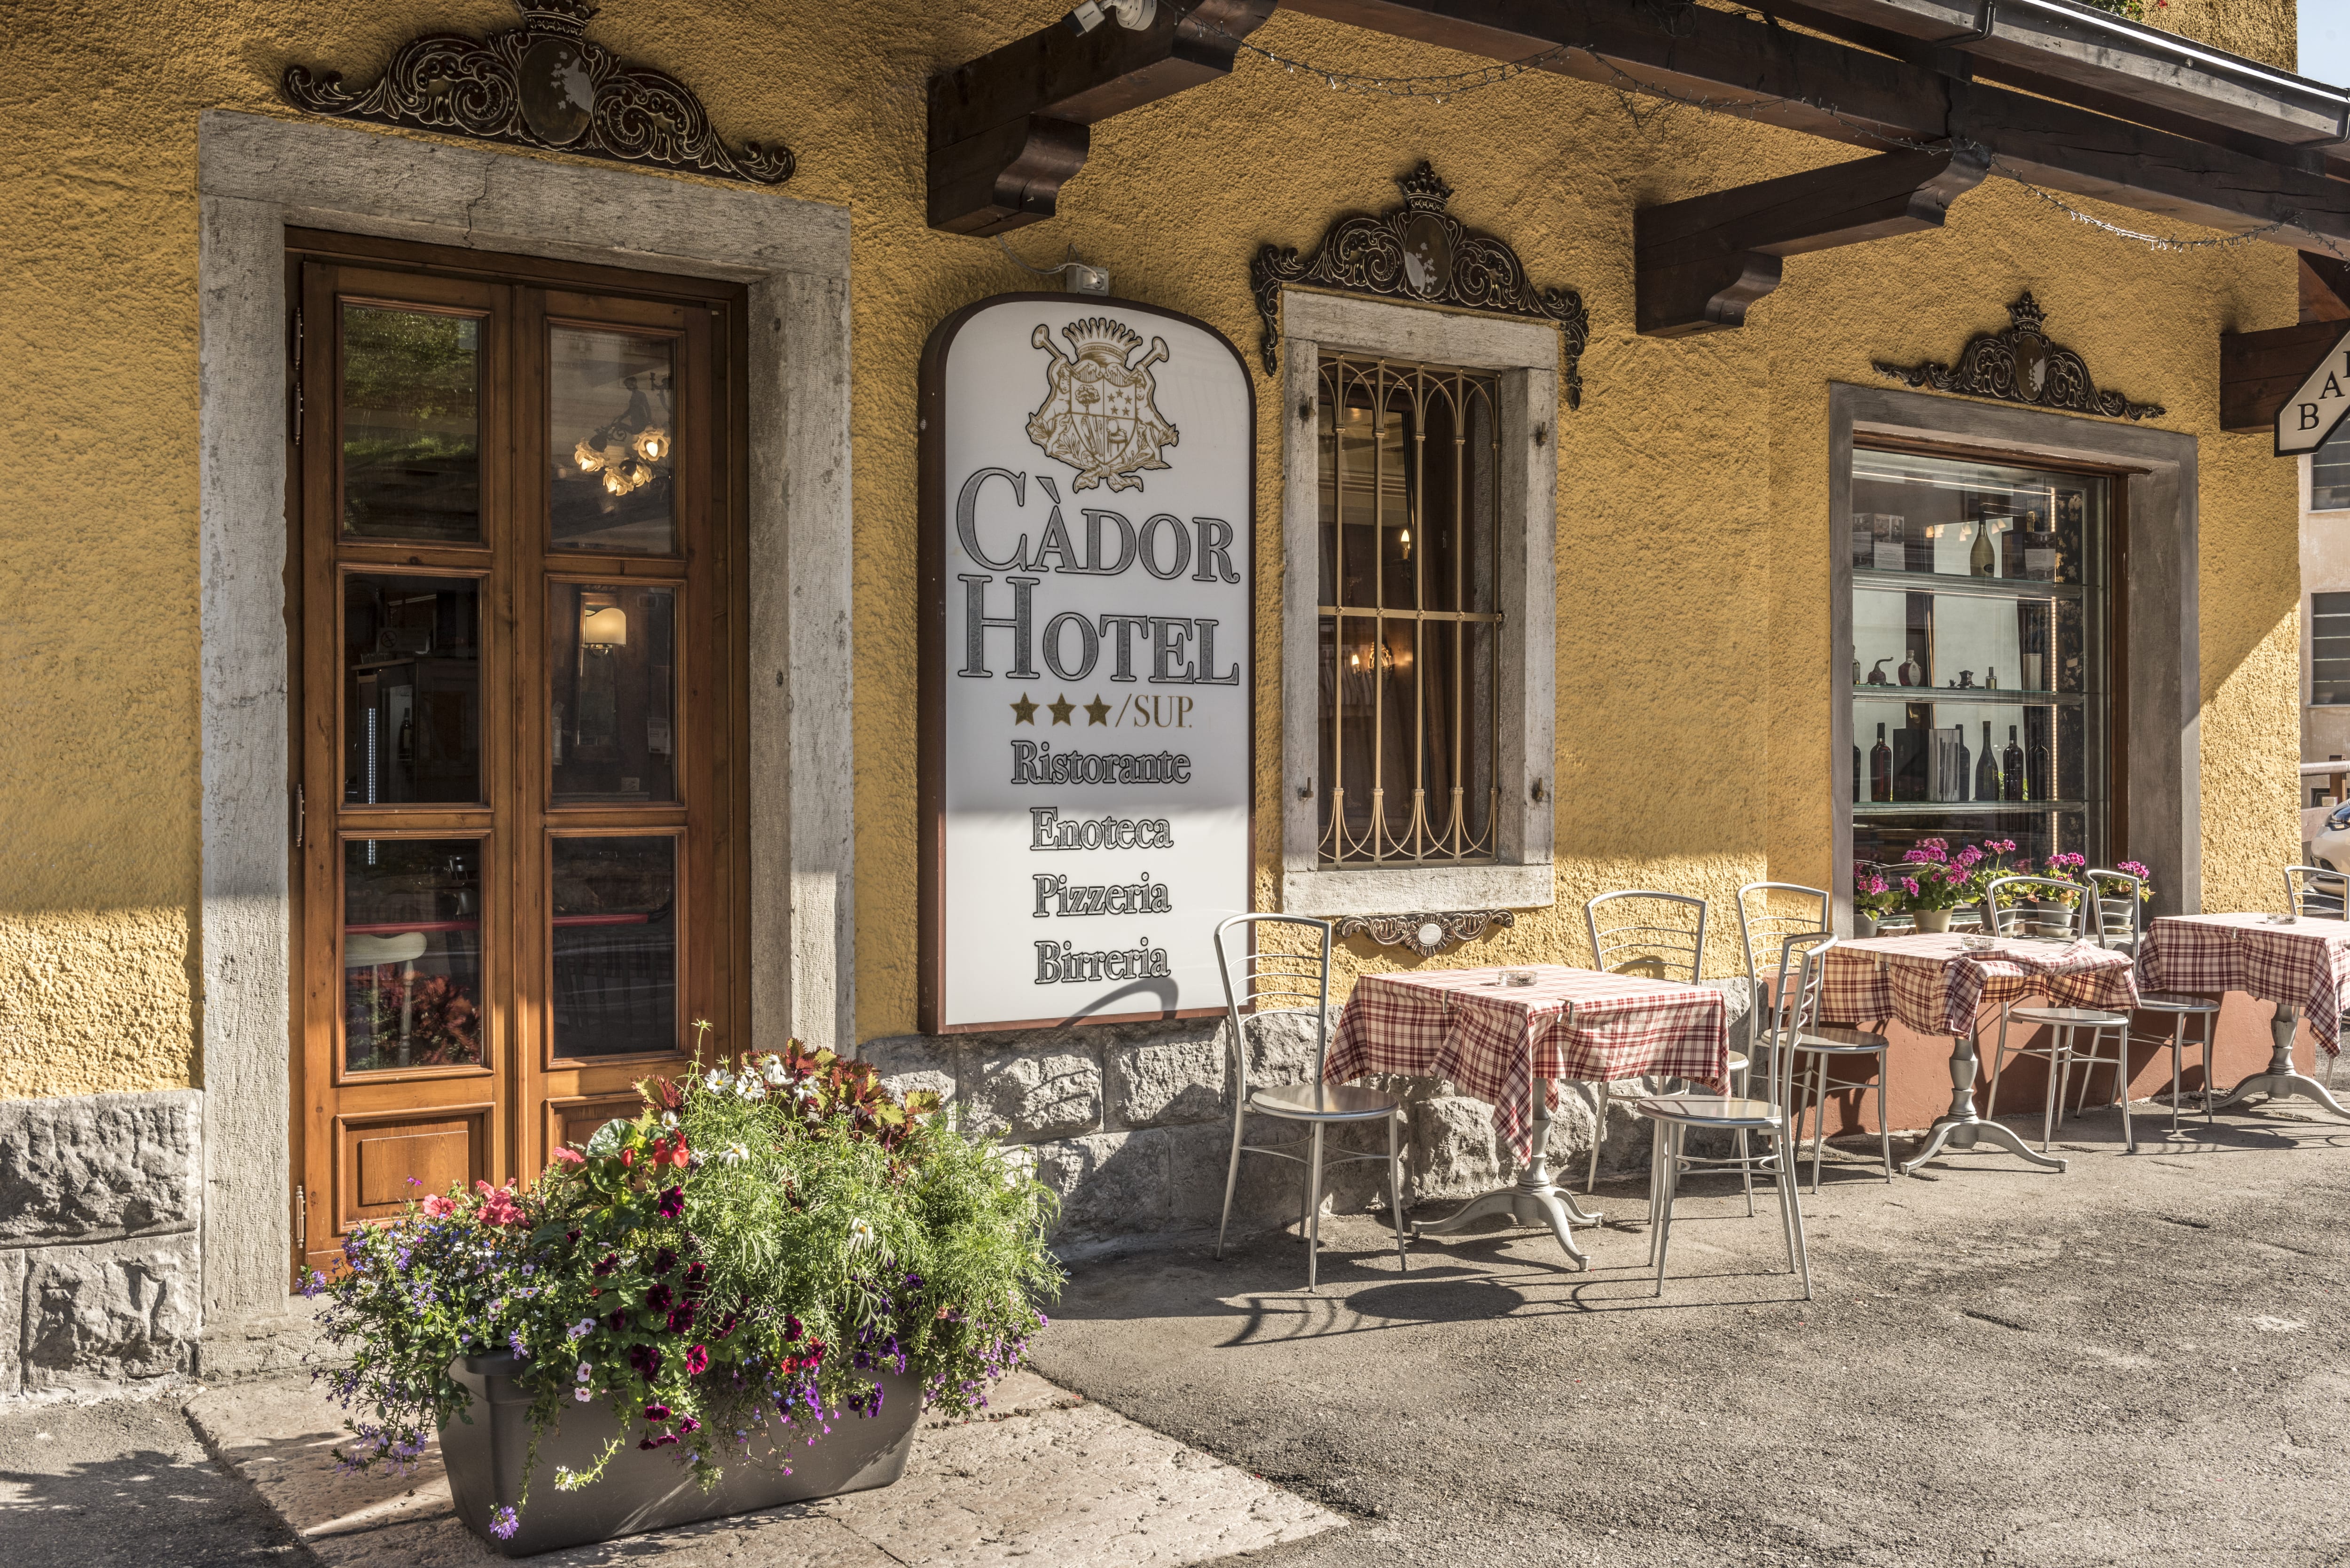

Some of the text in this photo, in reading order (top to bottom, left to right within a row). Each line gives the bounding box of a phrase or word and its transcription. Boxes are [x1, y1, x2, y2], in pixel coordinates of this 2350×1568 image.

[2297, 351, 2350, 431] BA
[956, 467, 1240, 583] CÀDOR
[957, 574, 1239, 685] HOTEL
[1011, 740, 1191, 784] Ristorante
[1030, 807, 1174, 850] Enoteca
[1033, 872, 1172, 917] Pizzeria
[1034, 937, 1171, 984] Birreria
